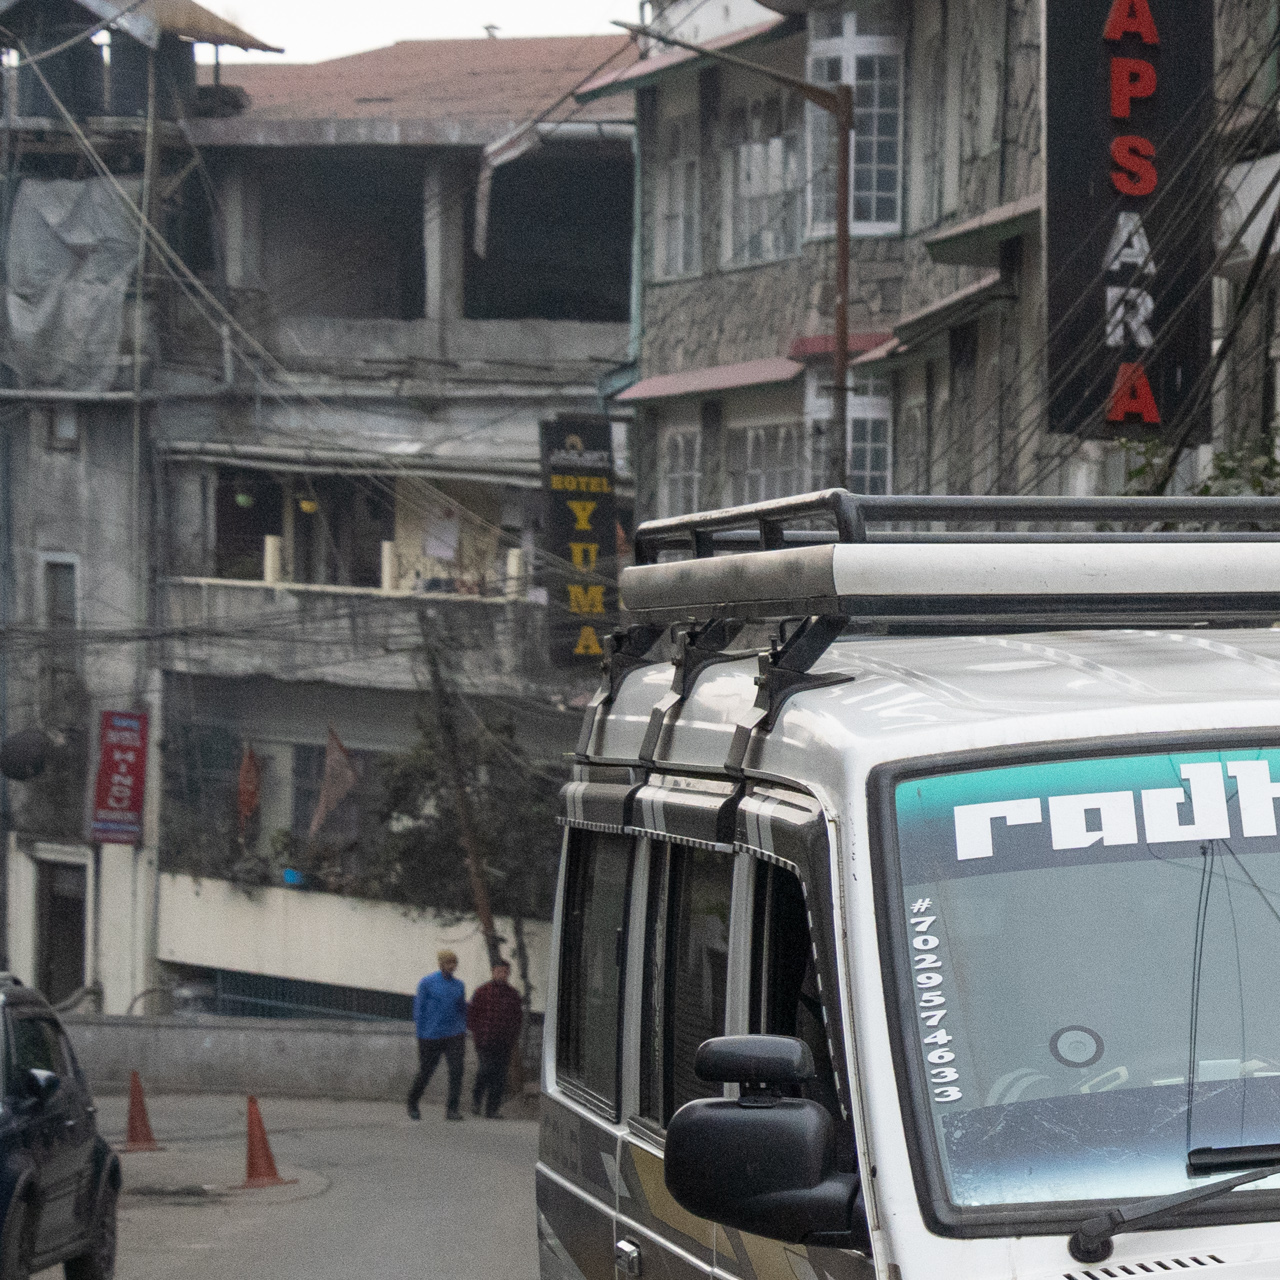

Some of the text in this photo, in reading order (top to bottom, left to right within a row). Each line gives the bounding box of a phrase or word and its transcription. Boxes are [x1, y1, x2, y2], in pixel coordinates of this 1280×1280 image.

[1103, 0, 1162, 424] APSARA
[551, 475, 613, 493] HOTEL
[567, 500, 606, 655] YUMA
[909, 897, 963, 1102] #7029574633
